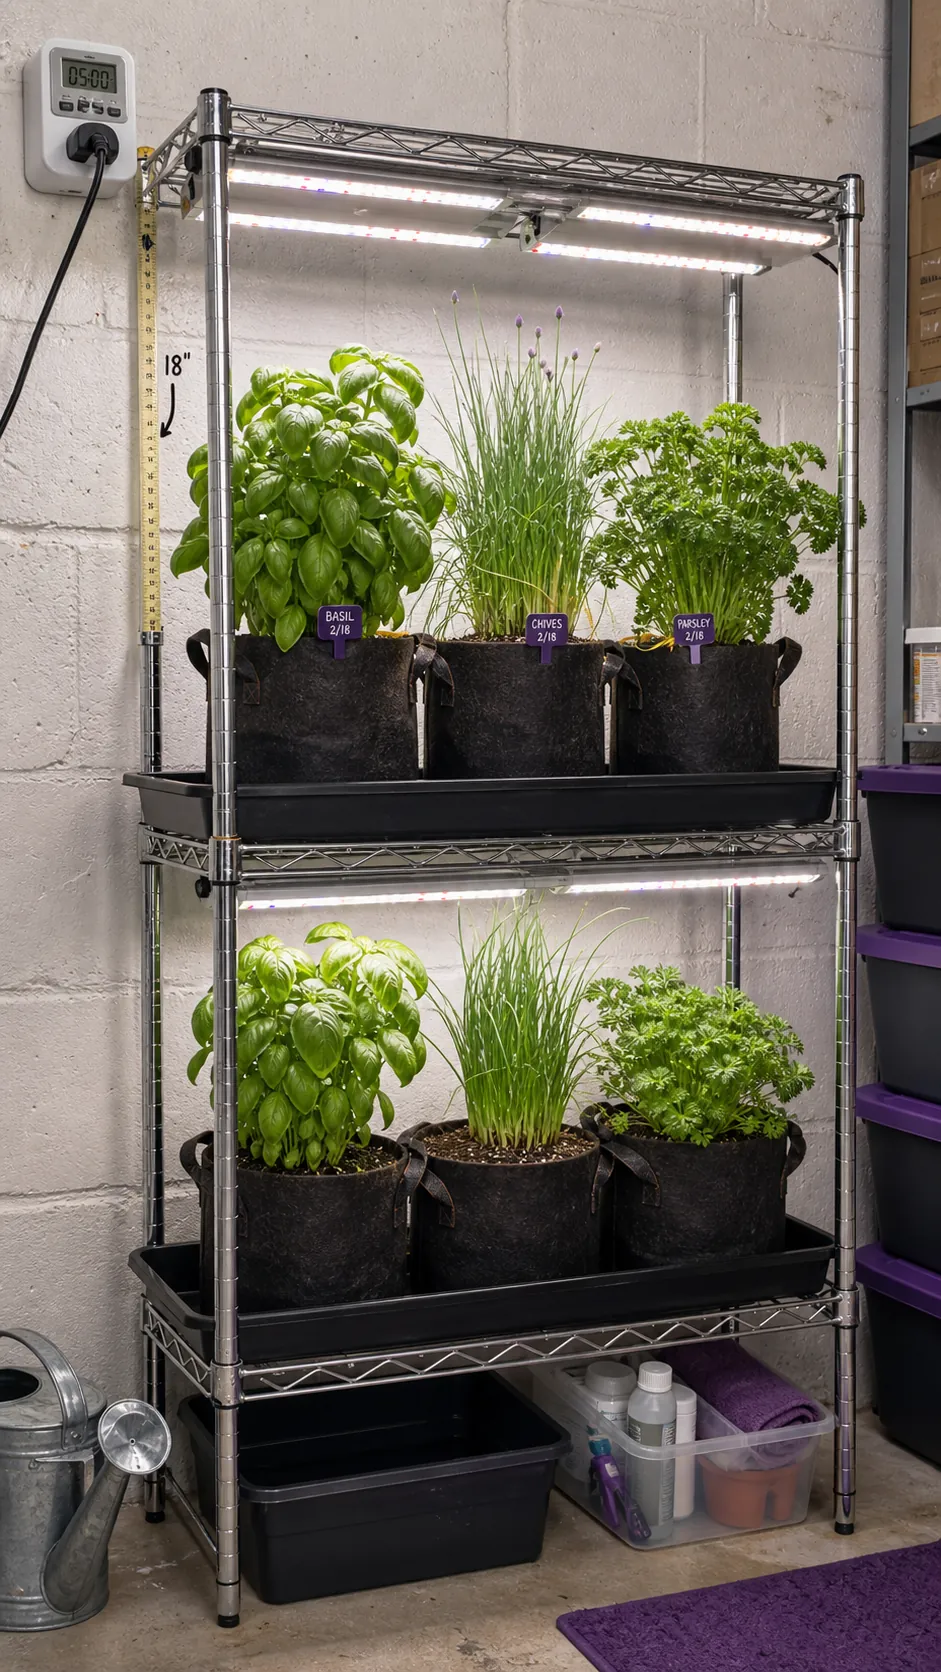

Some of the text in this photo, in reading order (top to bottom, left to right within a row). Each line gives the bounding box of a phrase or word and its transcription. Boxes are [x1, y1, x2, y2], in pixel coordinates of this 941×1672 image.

[68, 66, 109, 89] 05:00
[165, 352, 190, 376] 18"
[325, 611, 355, 622] BASIL
[531, 618, 563, 629] CHIVES
[677, 617, 711, 629] PARSLEY
[330, 624, 351, 637] 2/18
[537, 631, 557, 643] 2/18
